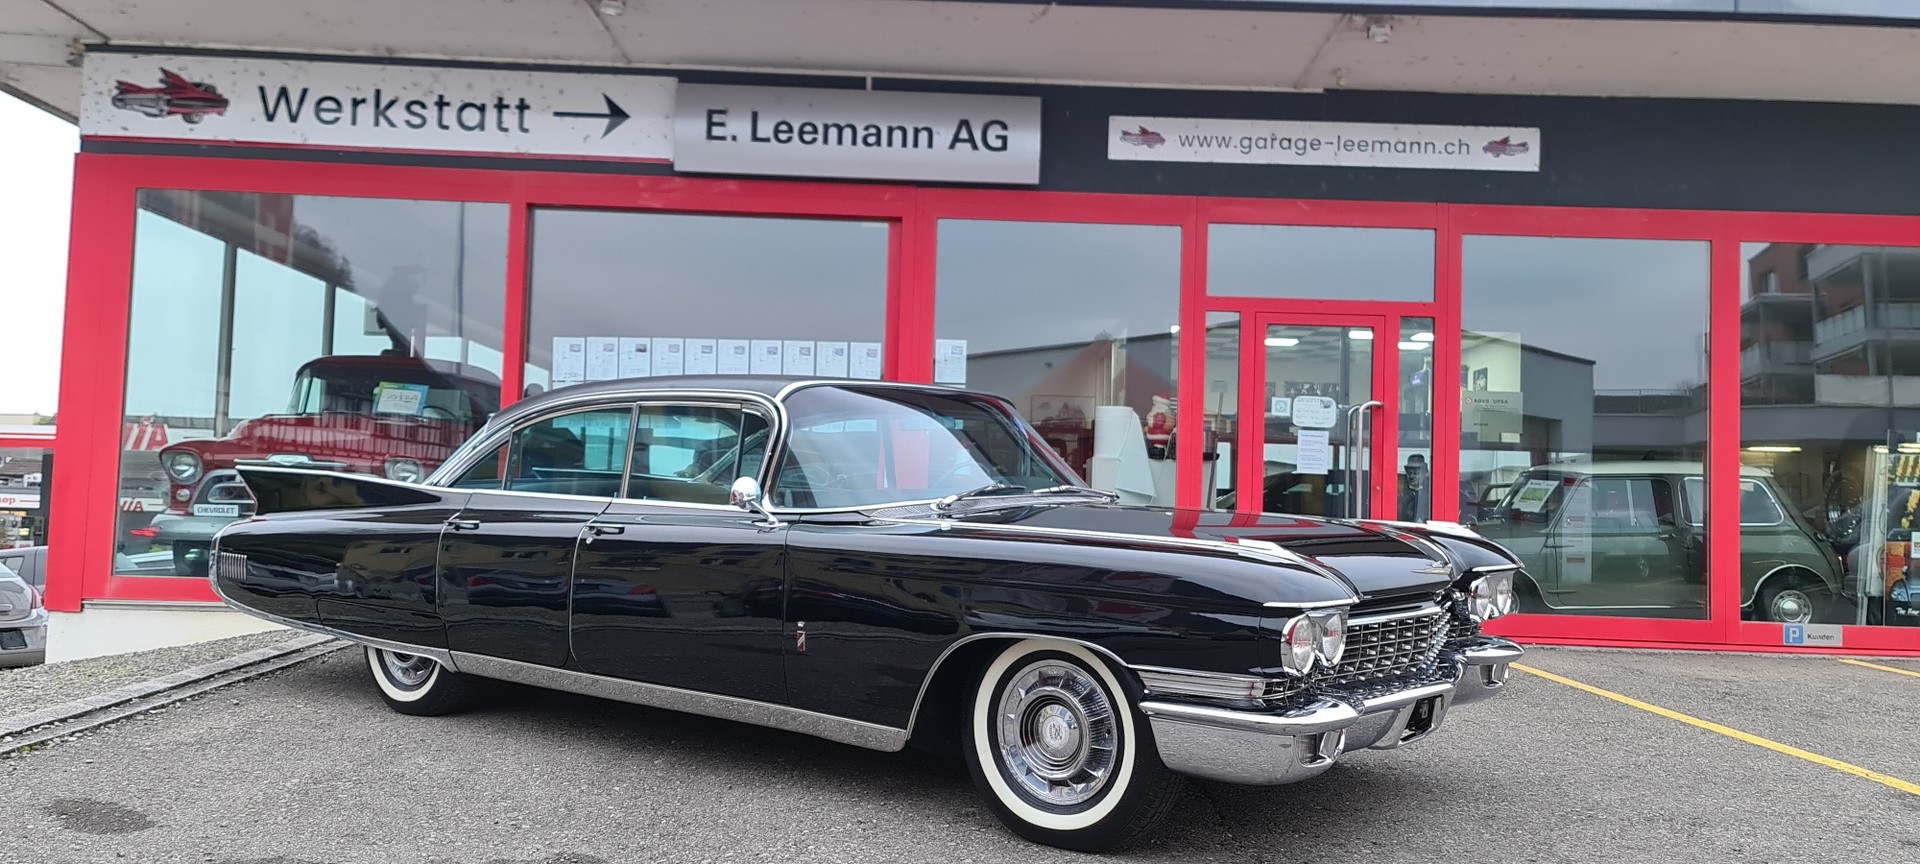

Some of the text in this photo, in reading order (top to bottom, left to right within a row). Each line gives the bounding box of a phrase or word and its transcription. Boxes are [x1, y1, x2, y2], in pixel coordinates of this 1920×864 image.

[258, 85, 531, 135] Werkstatt
[705, 109, 1009, 152] E. Leemann AG
[1177, 131, 1471, 157] www.garage-leemann.ch
[197, 506, 235, 514] CHEVROLET
[1789, 627, 1835, 643] P Kunden
